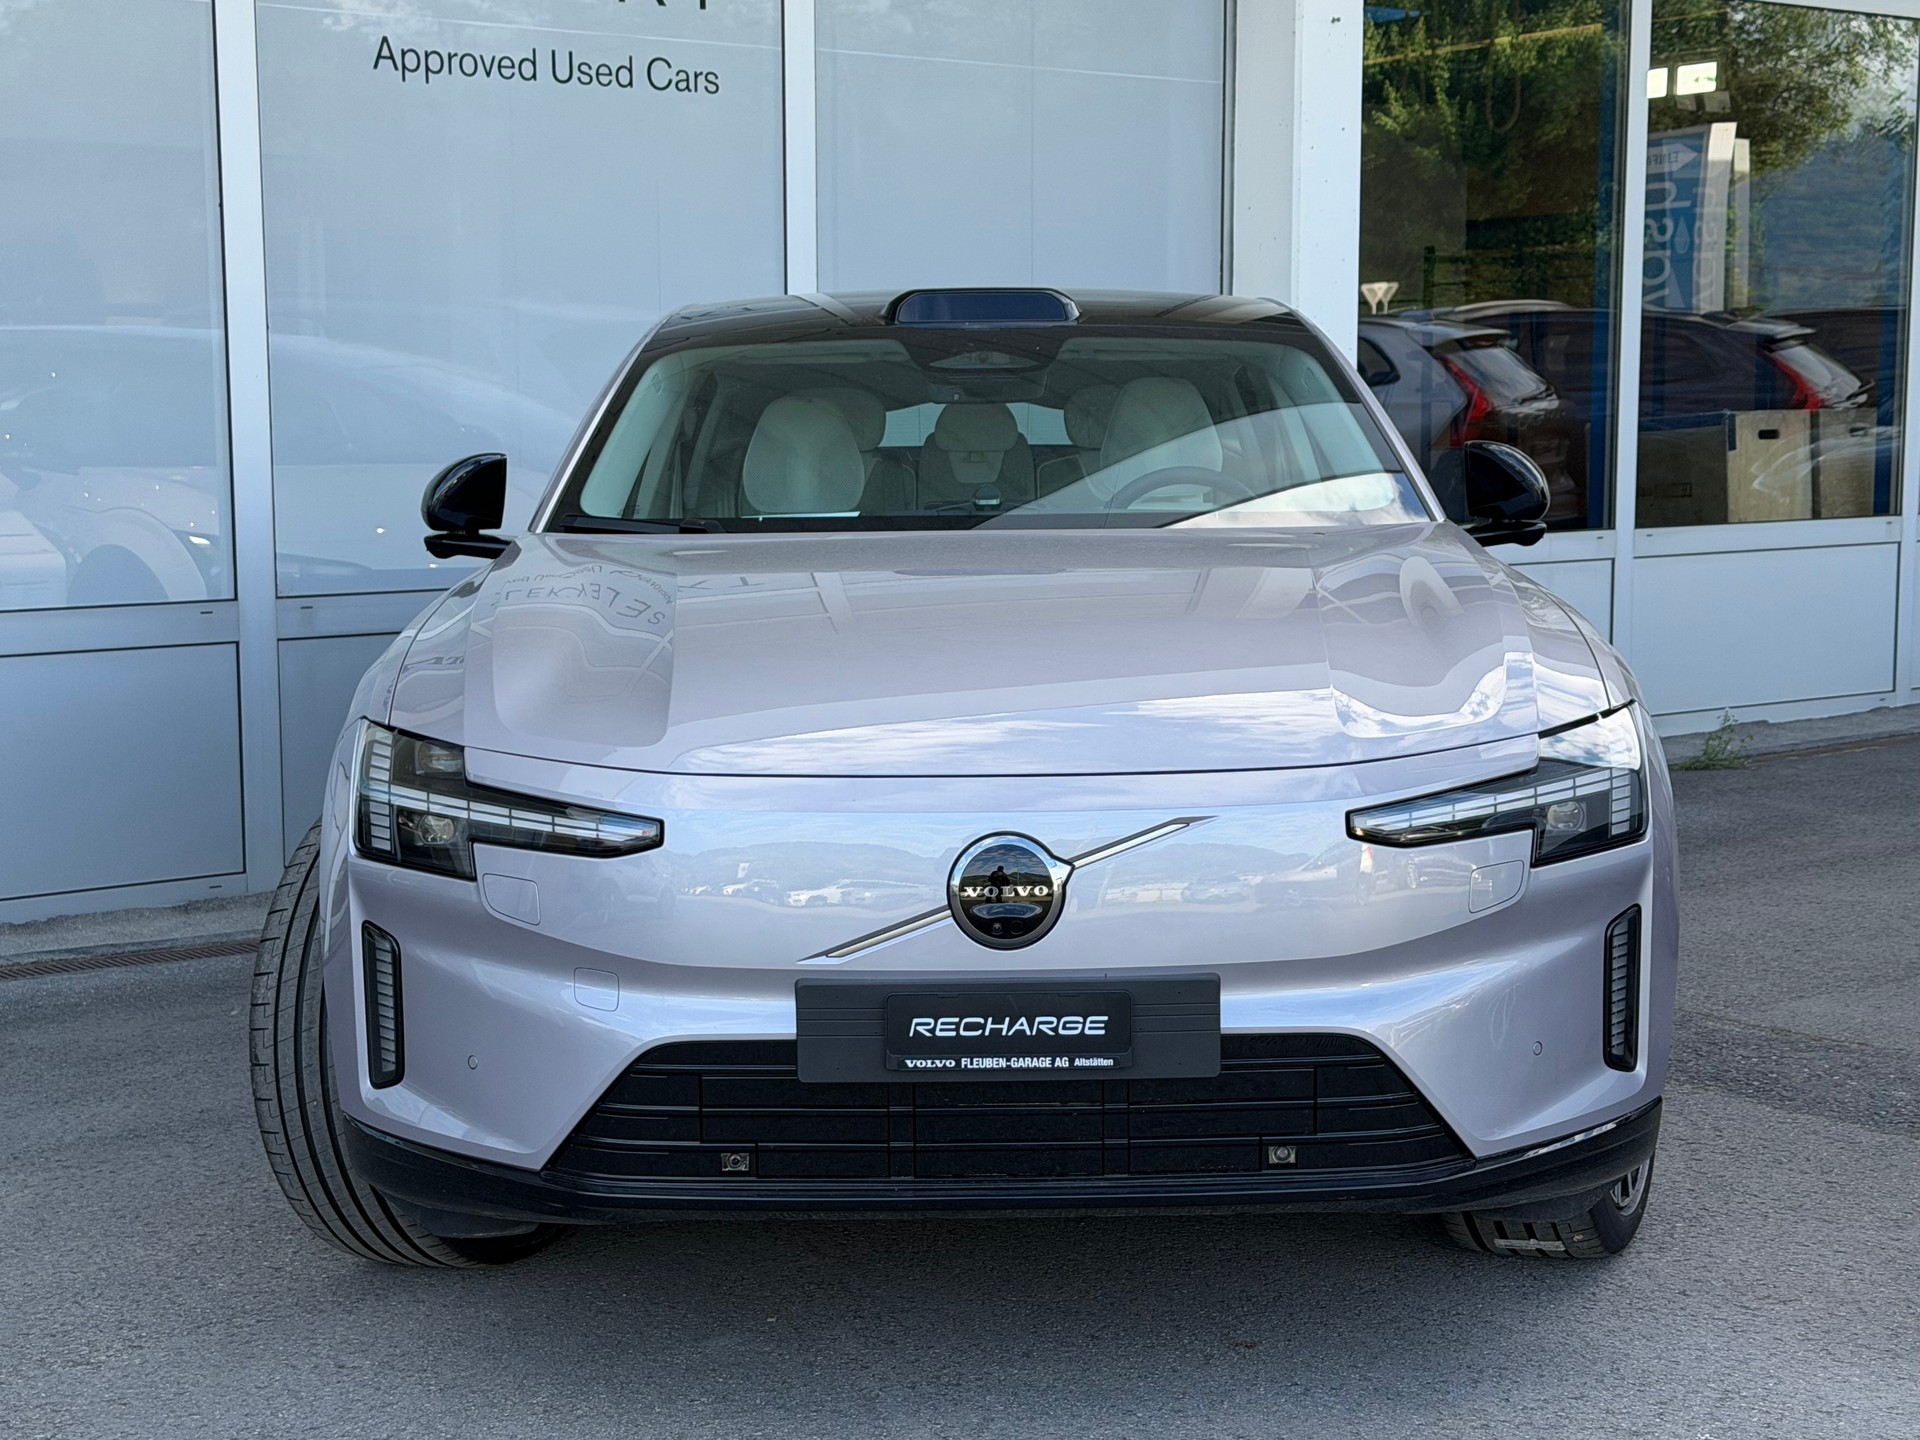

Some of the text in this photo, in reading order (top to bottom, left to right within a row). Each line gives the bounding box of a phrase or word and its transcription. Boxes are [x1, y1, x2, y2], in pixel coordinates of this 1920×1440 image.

[373, 36, 721, 95] Approved Used Cars
[963, 884, 1049, 897] VOLVO
[909, 1015, 1109, 1037] RECHARGE
[904, 1057, 1114, 1069] VOLVO FLEUBEN-GARAGE AG Altstätten
